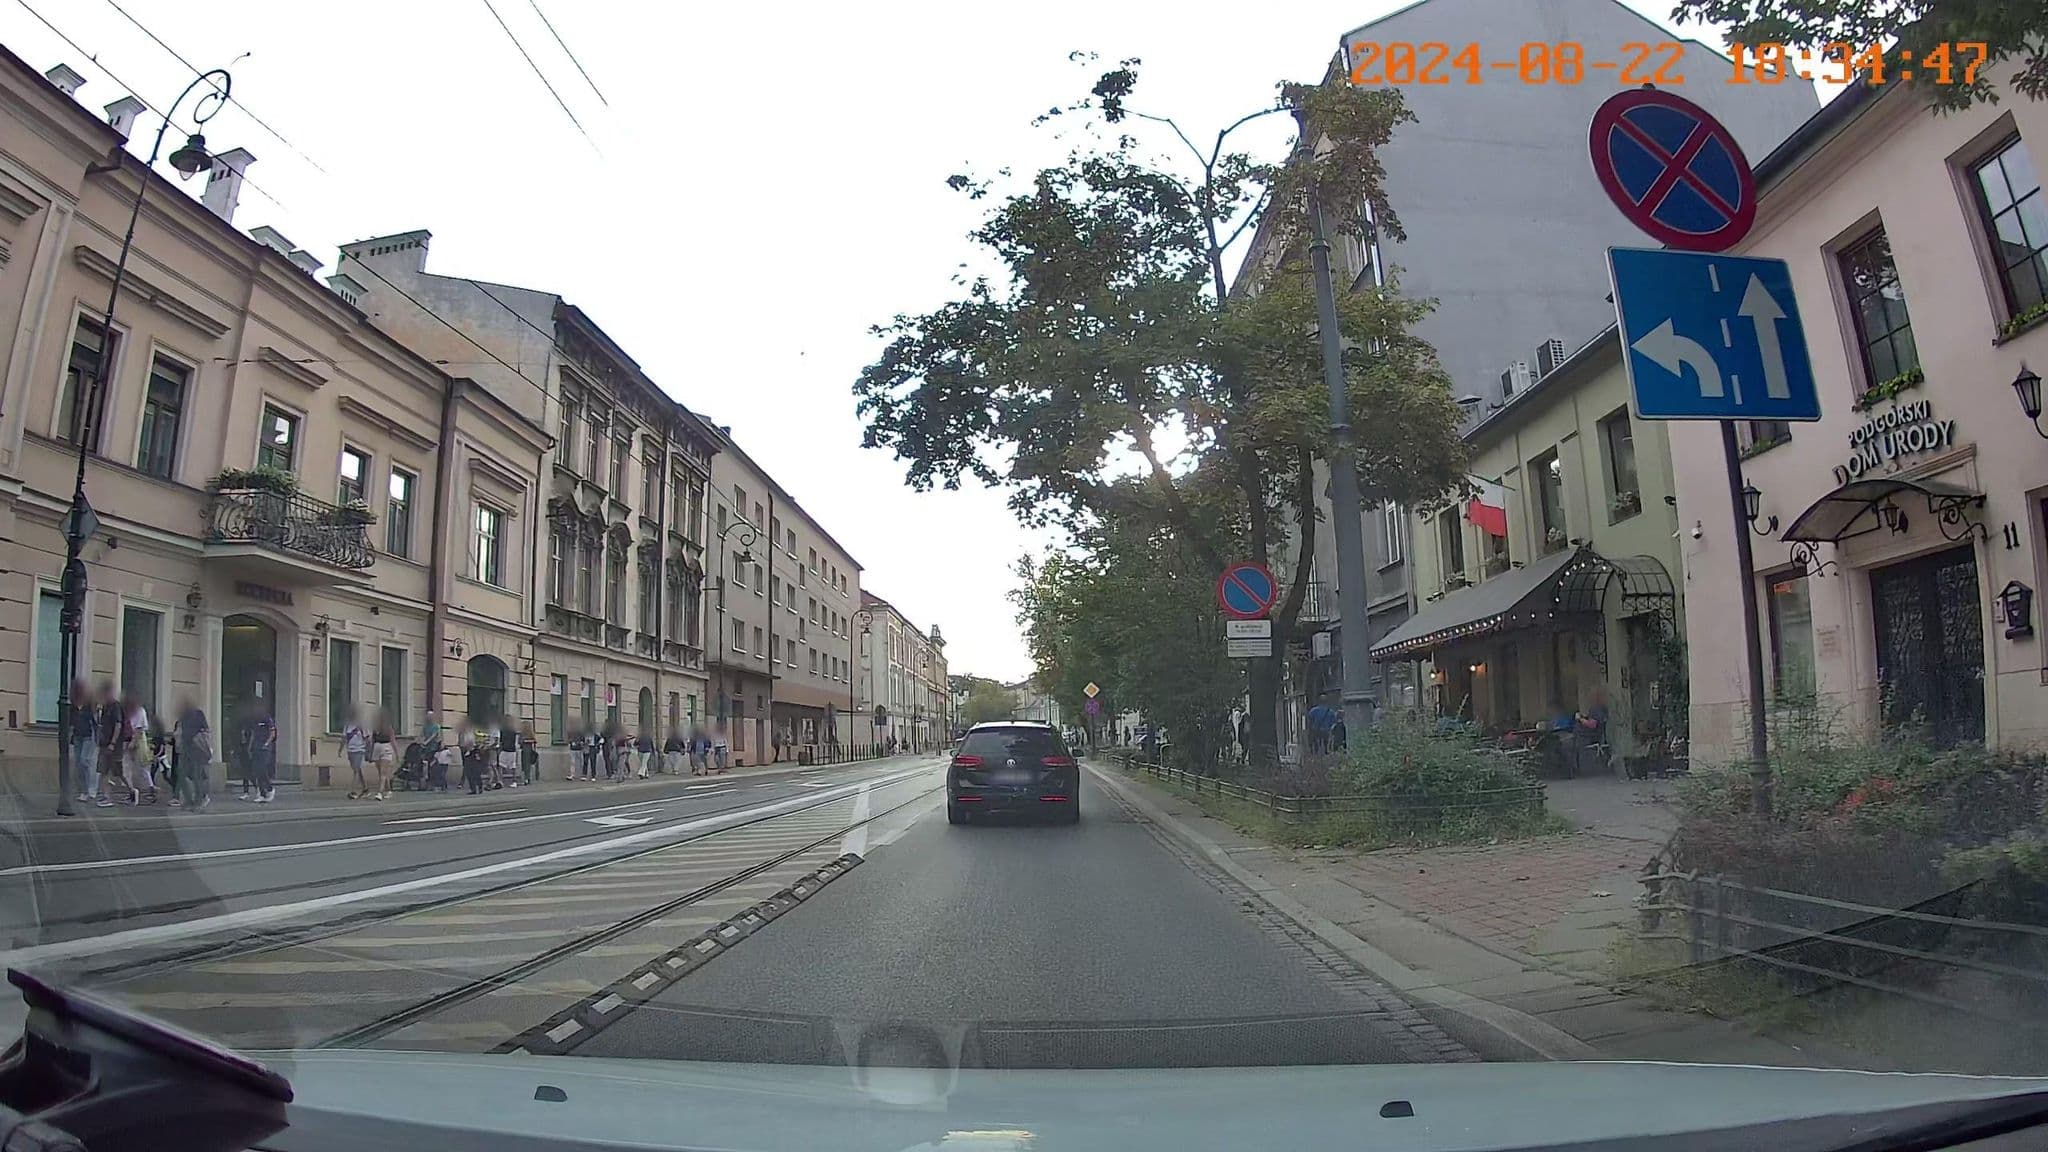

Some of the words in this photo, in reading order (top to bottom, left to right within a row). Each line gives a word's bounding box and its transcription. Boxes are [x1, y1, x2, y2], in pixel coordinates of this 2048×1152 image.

[1848, 400, 1931, 449] PODGÓRSKI
[1832, 438, 1882, 485] DOM
[1883, 420, 1955, 459] URODY
[2003, 521, 2020, 549] 11
